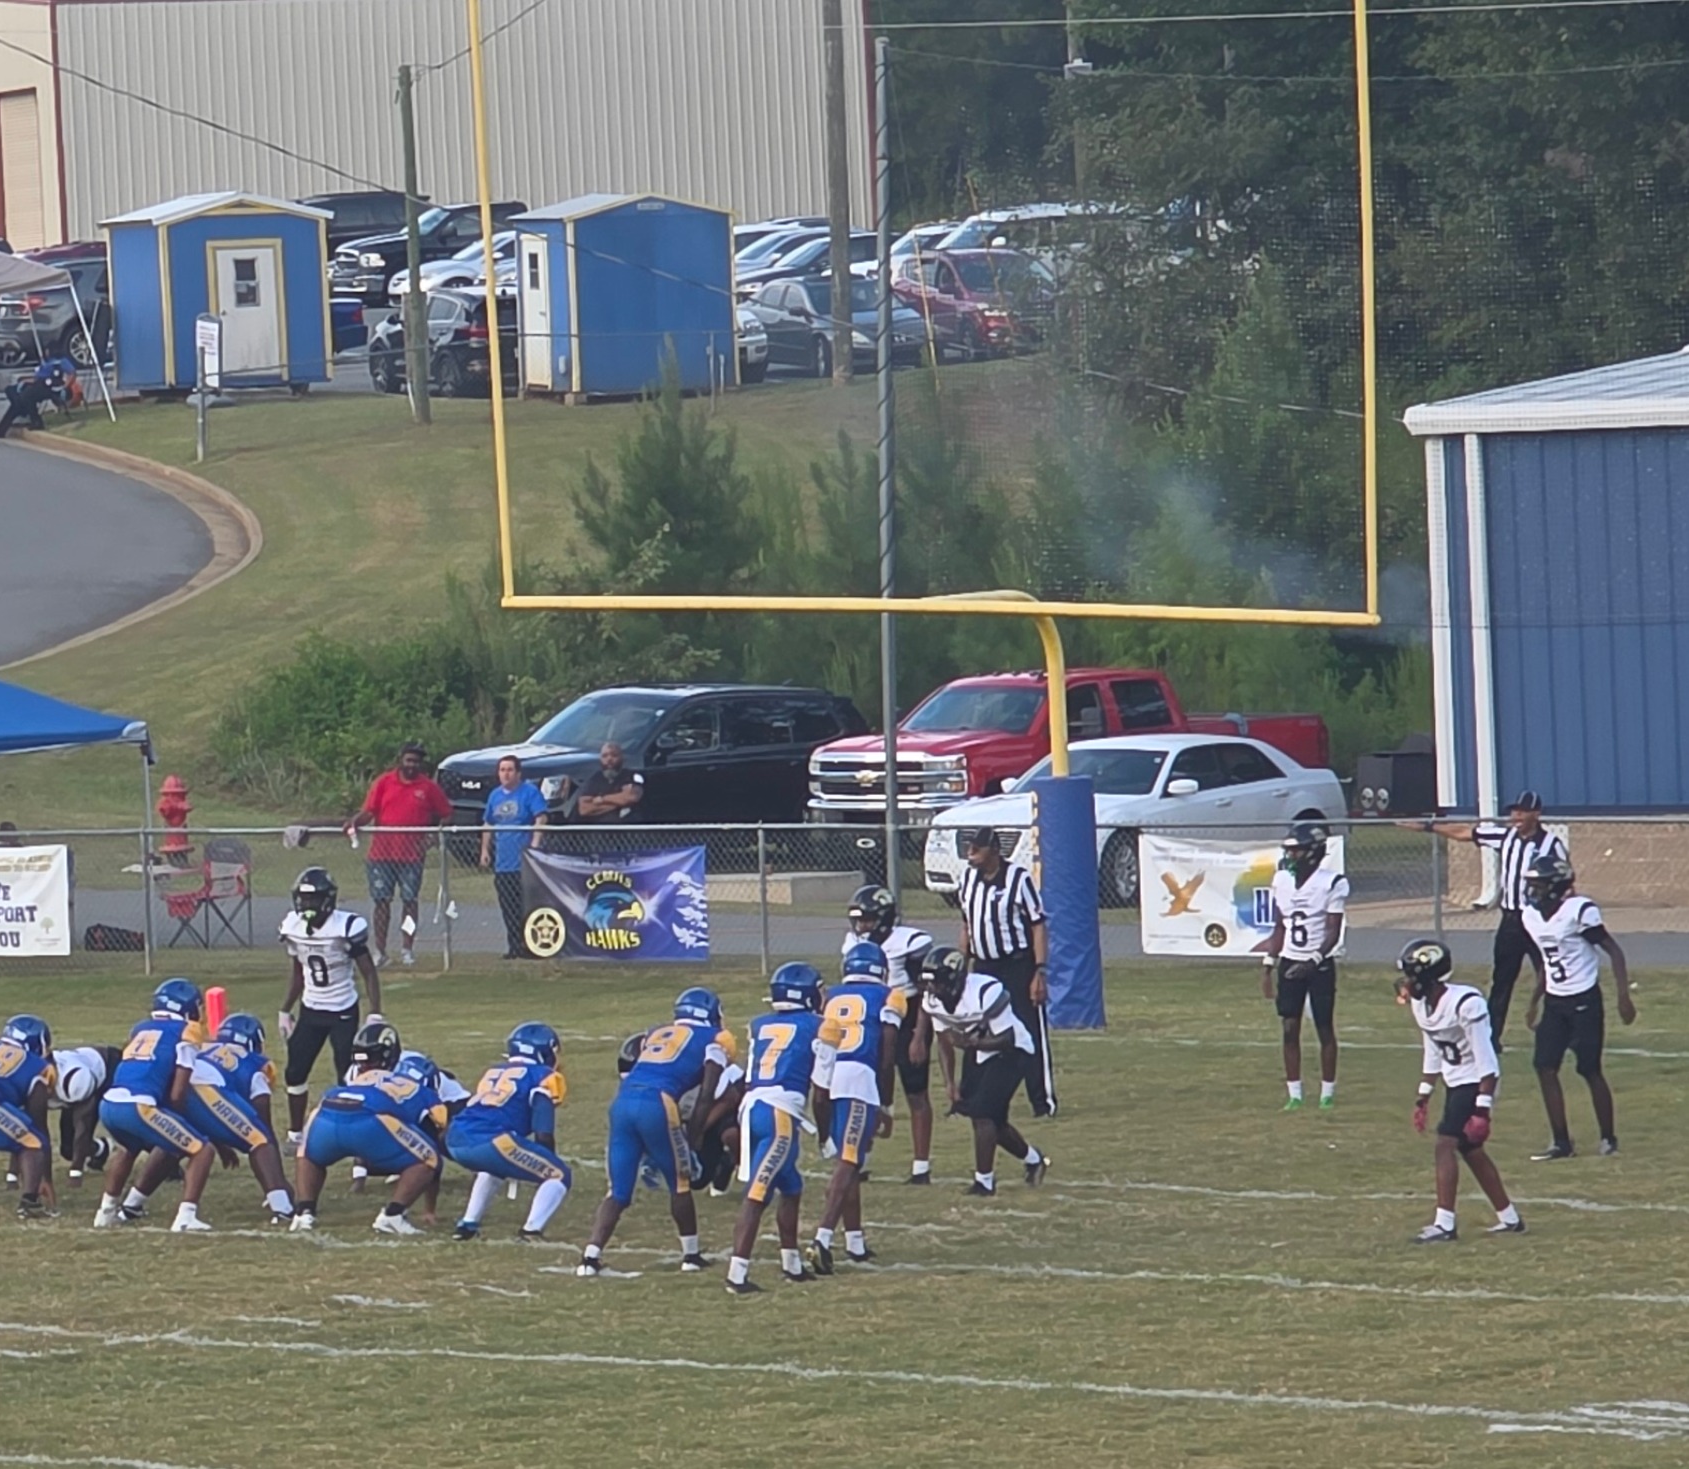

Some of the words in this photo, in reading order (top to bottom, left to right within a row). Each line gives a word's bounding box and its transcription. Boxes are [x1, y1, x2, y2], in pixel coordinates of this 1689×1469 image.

[585, 928, 642, 950] HAWKS
[1290, 910, 1308, 948] 6
[824, 994, 867, 1054] 8
[758, 1022, 798, 1080] 7
[150, 1113, 193, 1148] HAWKS
[212, 1099, 253, 1137] HAWKS
[846, 1101, 868, 1147] AWKS
[508, 1147, 561, 1179] HAWKS
[759, 1135, 790, 1187] HAWKS
